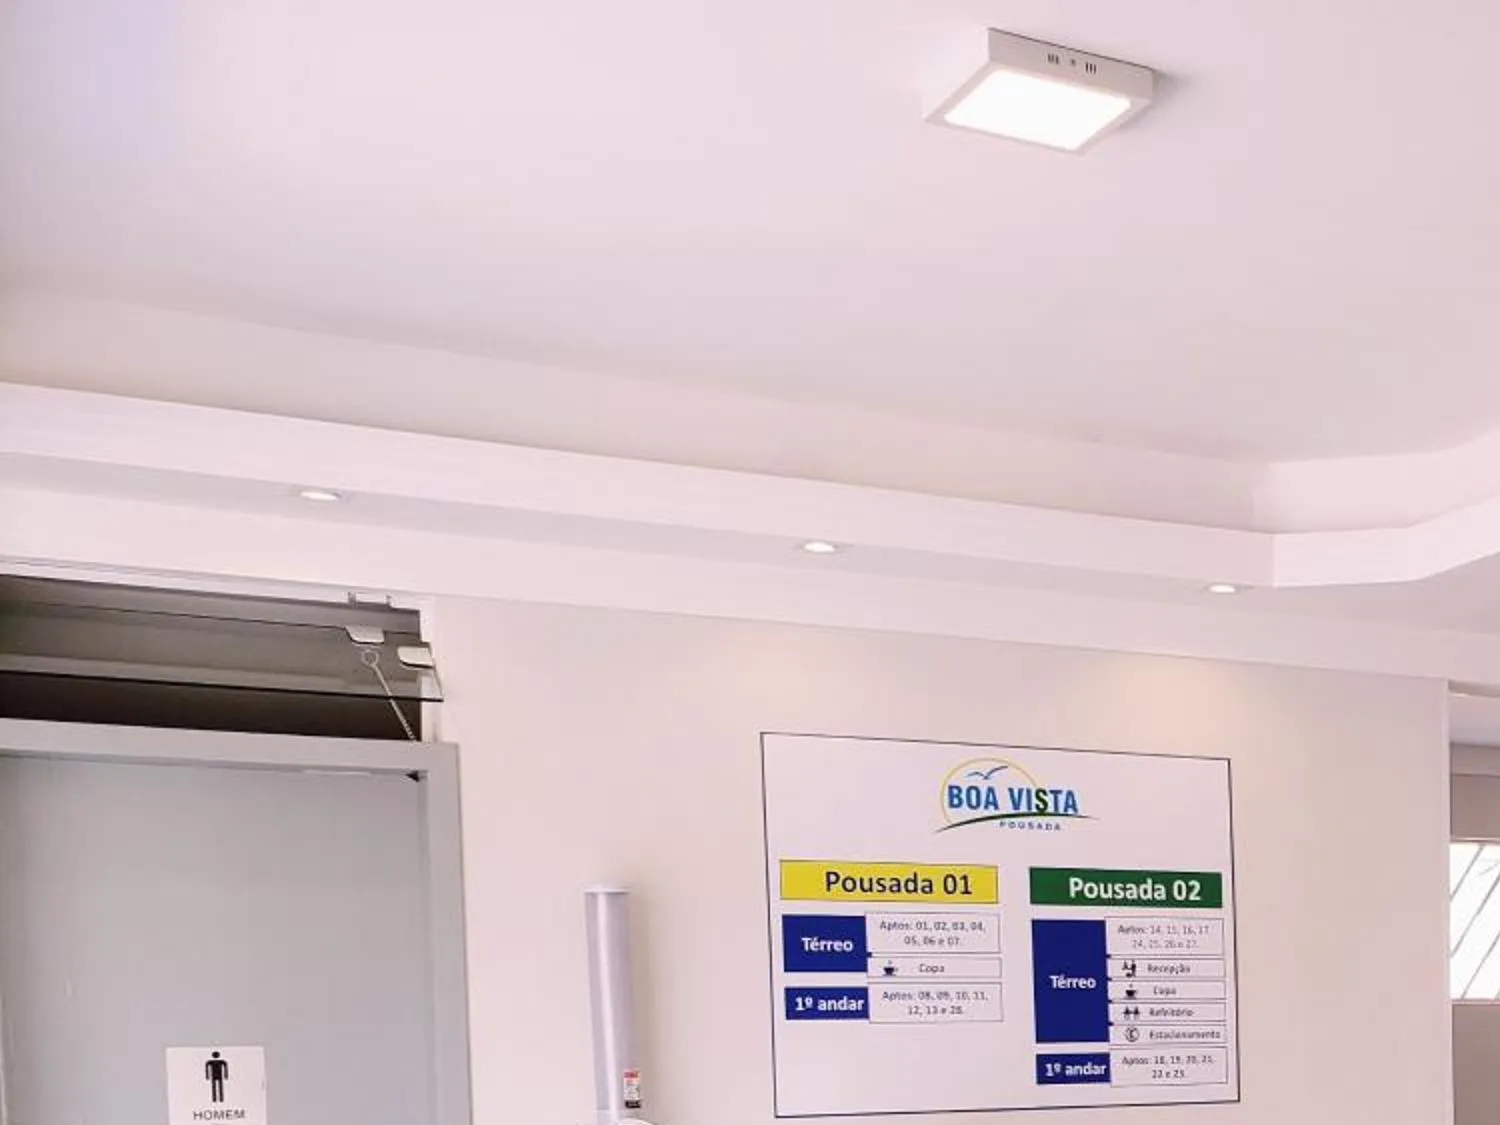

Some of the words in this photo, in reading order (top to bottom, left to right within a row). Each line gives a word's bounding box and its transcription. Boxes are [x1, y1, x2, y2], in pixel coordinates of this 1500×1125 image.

[947, 784, 999, 810] BOA
[1008, 787, 1079, 813] VISTA
[1000, 821, 1061, 831] POUSADA
[825, 871, 934, 895] Pousada
[943, 874, 973, 895] 01
[1068, 877, 1167, 900] Pousada
[1173, 880, 1201, 901] 02
[801, 936, 853, 952] Térreo
[919, 963, 945, 974] Copa
[1049, 974, 1097, 989] Térreo
[795, 996, 812, 1011] 1º
[818, 996, 864, 1011] andar
[1045, 1062, 1061, 1077] 1º
[1065, 1061, 1107, 1076] andar
[193, 1109, 246, 1121] HOMEM
